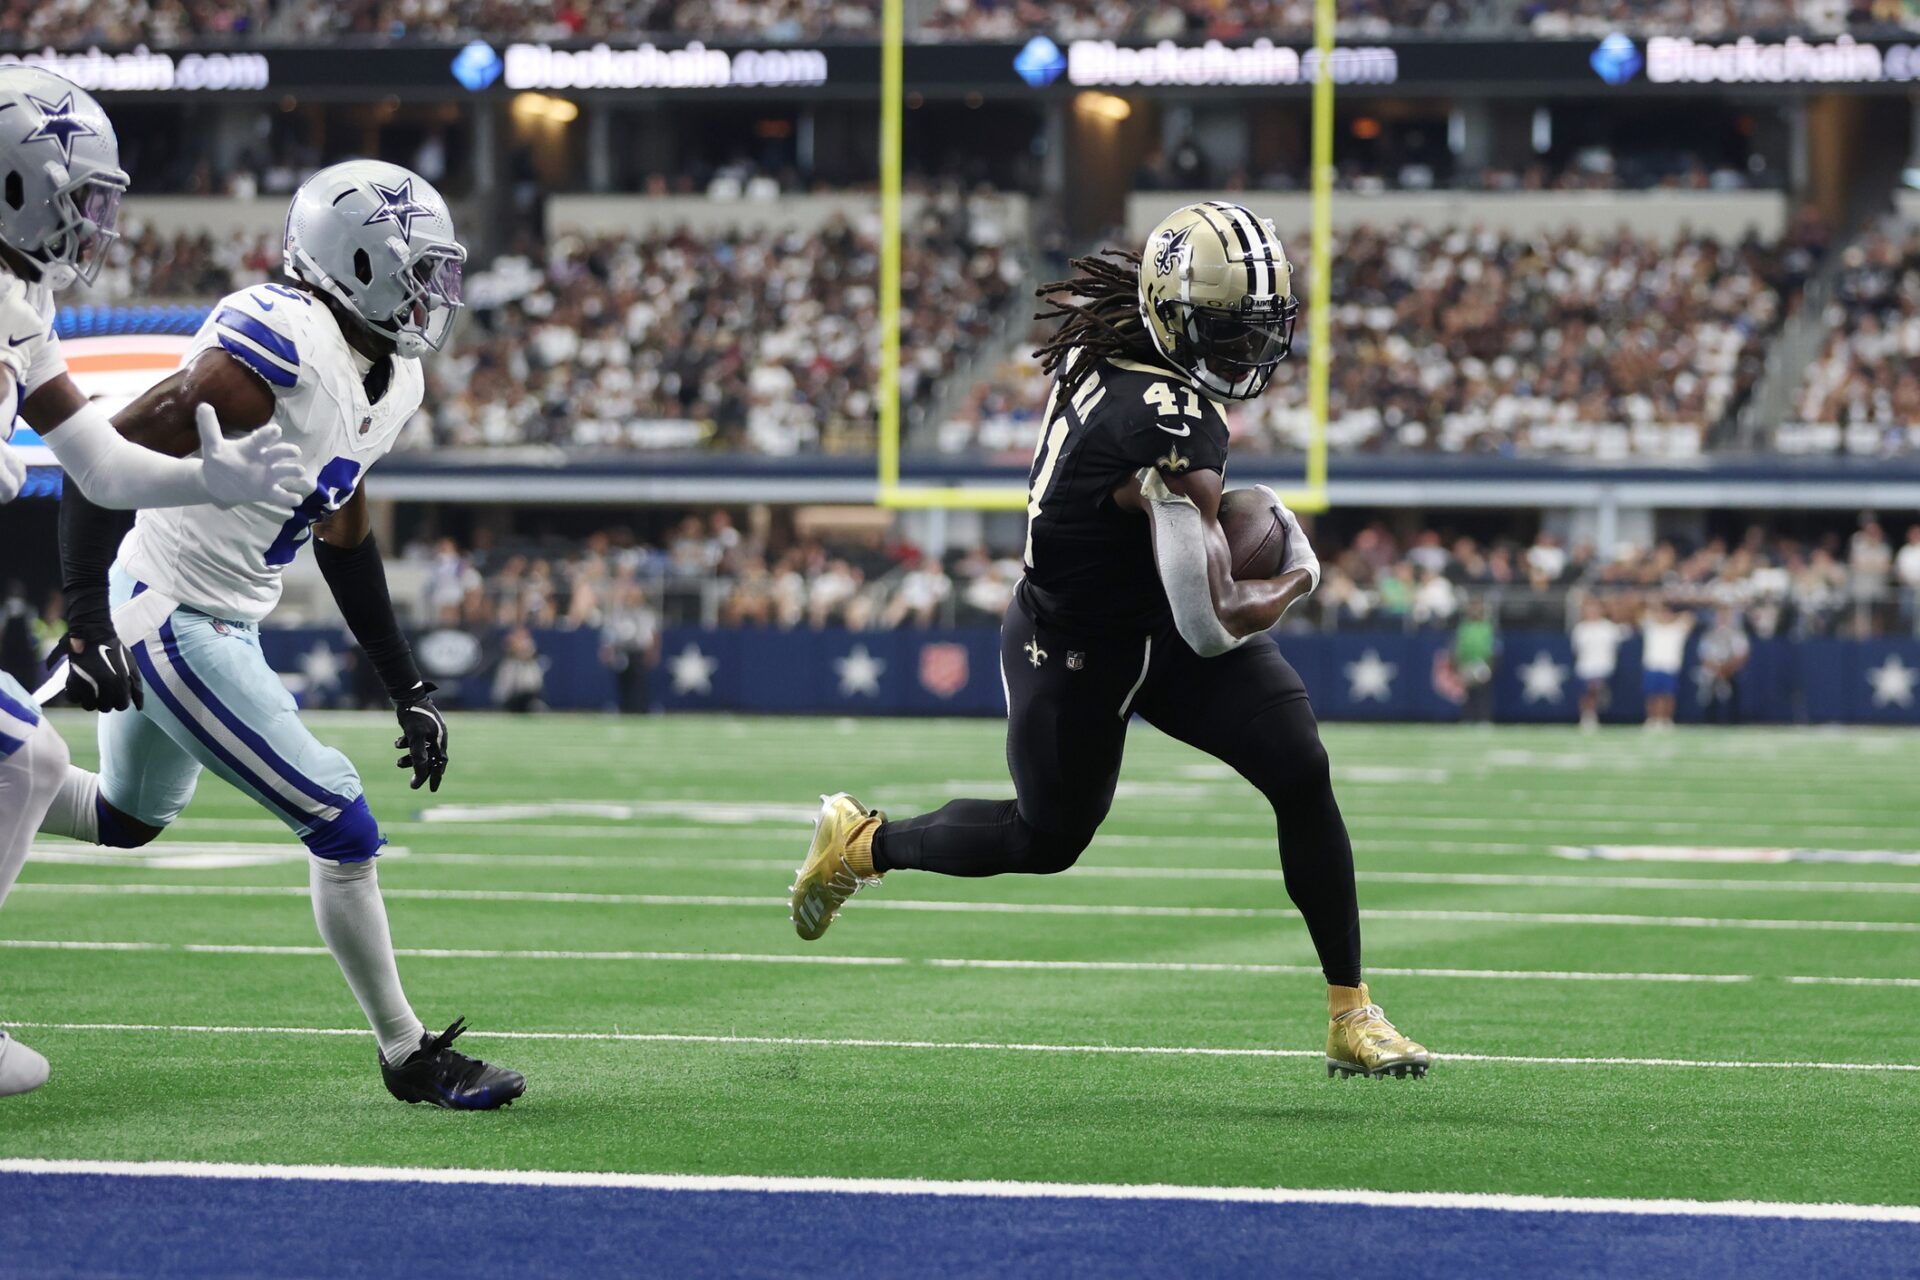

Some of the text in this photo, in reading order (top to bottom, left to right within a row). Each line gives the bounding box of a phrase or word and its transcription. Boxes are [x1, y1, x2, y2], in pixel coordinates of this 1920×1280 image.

[504, 39, 828, 89] Blockchain.com
[1646, 33, 1920, 83] Blockchain.c
[1143, 382, 1202, 419] 41
